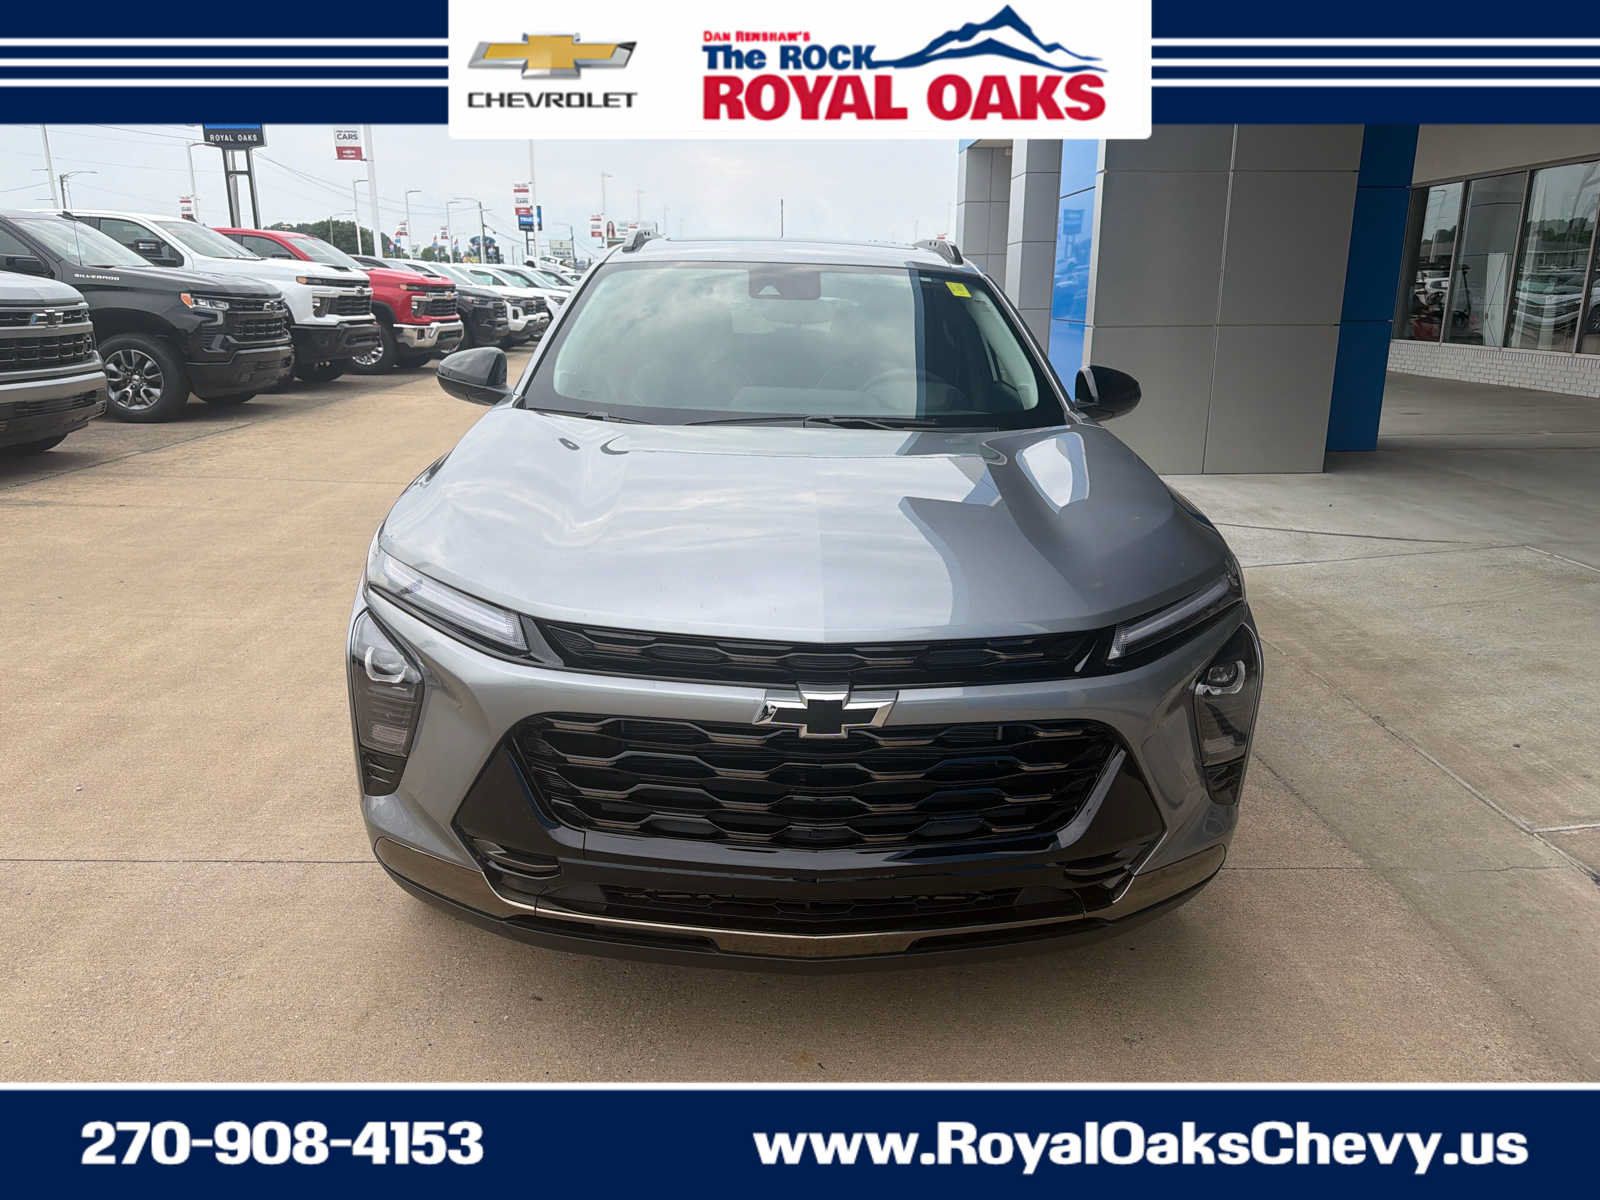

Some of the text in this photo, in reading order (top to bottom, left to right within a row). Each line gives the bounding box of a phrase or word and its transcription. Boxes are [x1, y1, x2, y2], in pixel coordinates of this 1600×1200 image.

[209, 134, 258, 142] ROYAL OAKS
[73, 273, 120, 281] SILVERADO
